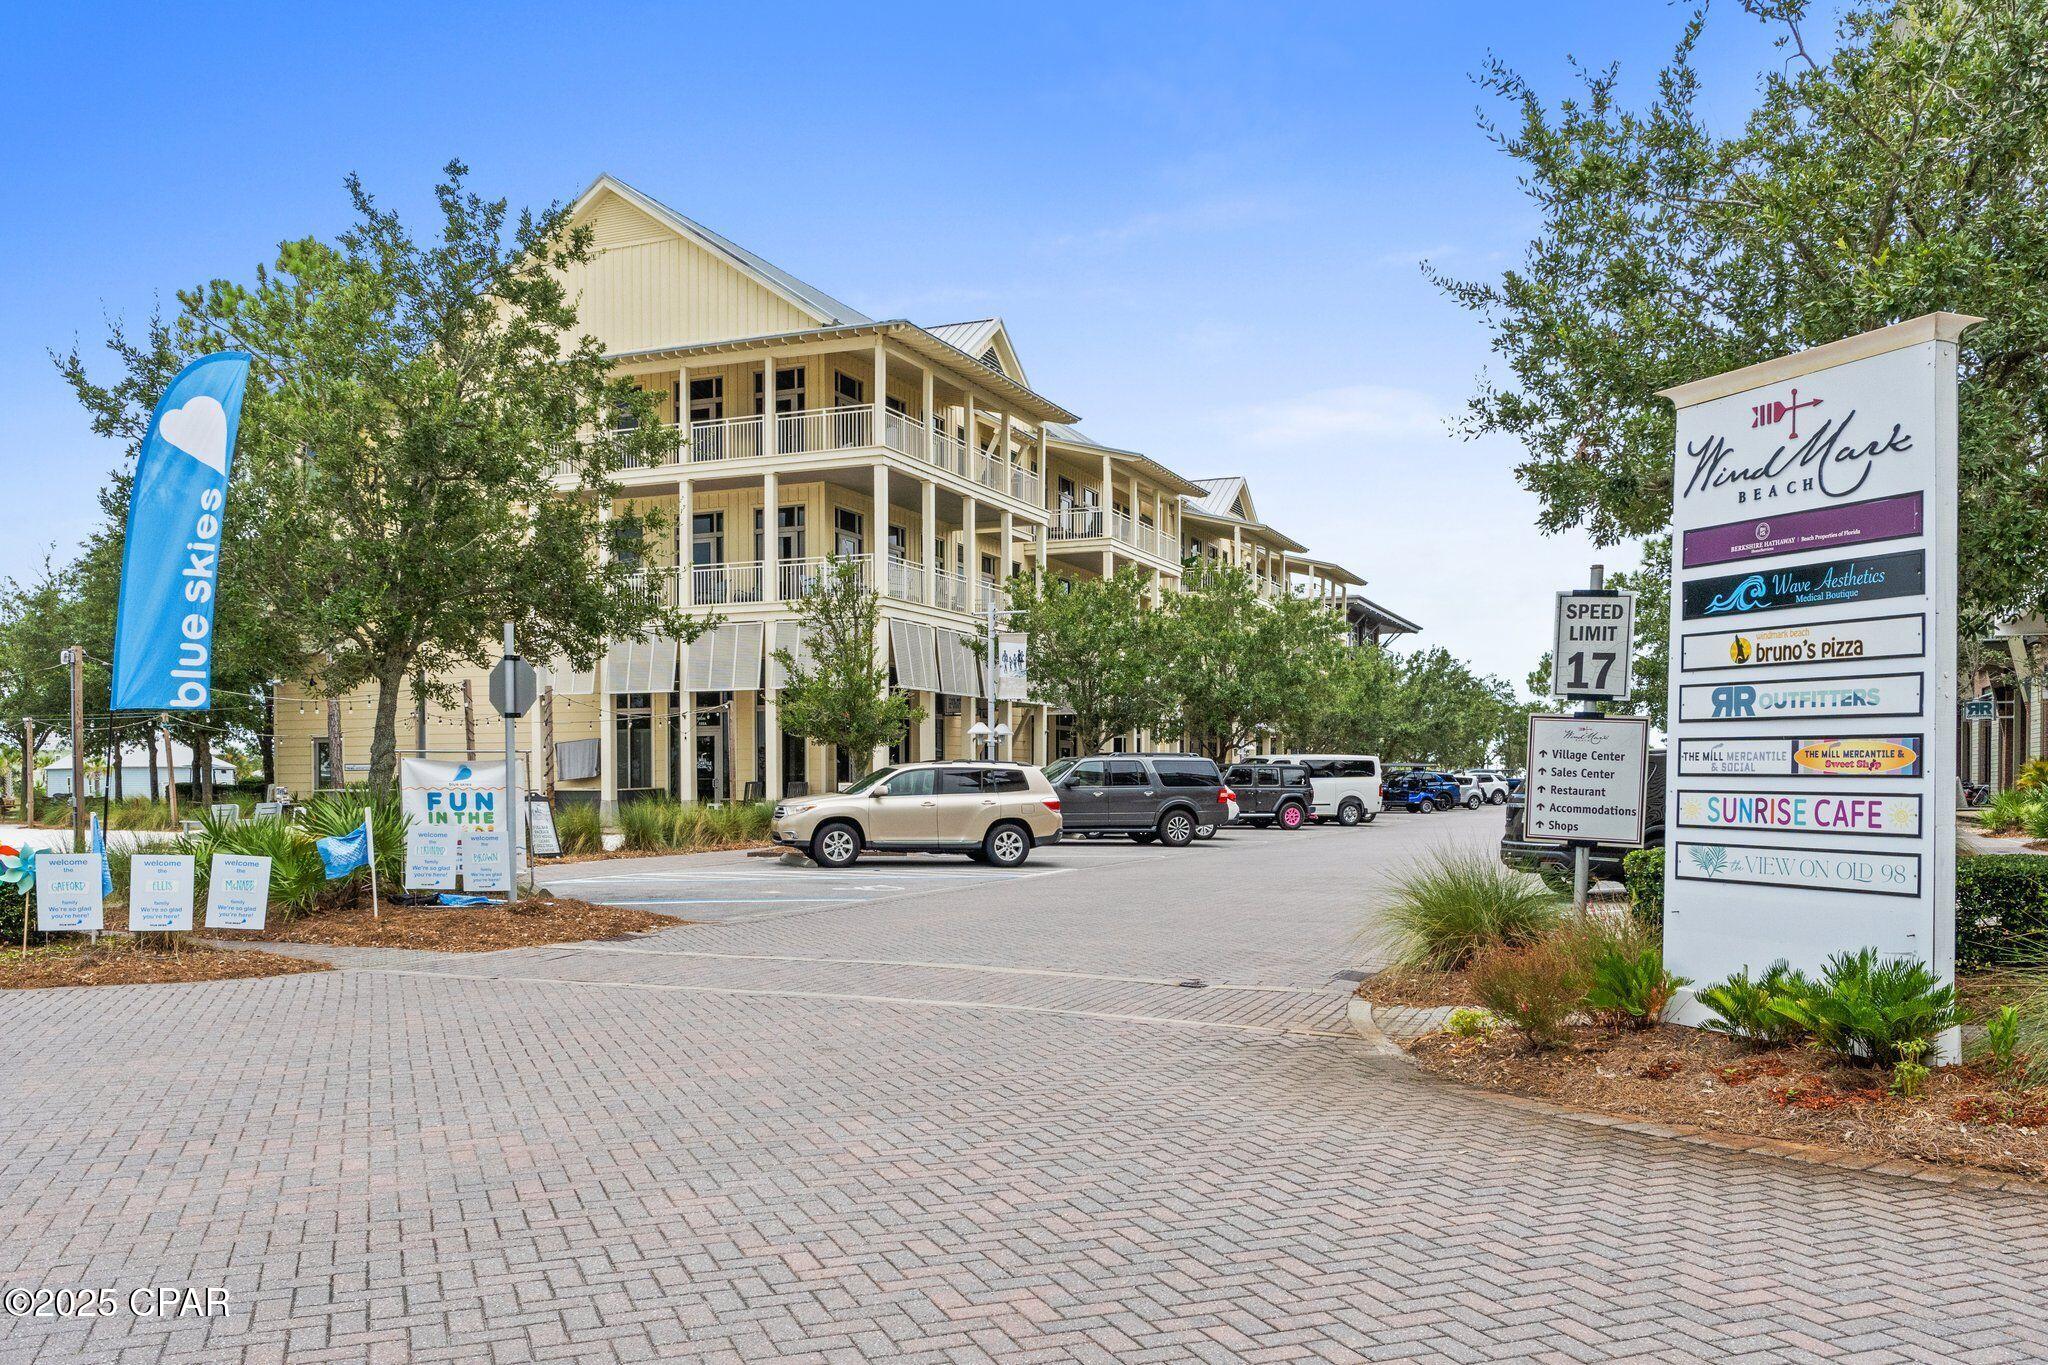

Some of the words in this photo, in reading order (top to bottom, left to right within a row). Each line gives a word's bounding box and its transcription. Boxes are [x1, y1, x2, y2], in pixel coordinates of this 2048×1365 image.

[1739, 478, 1814, 503] BEACH
[182, 488, 222, 604] skies
[1730, 542, 1763, 553] BERKSHIRE
[1764, 537, 1796, 547] HATHAWAY
[1843, 528, 1860, 536] Florida
[1772, 573, 1811, 595] Wave
[1814, 563, 1885, 591] Aesthetics
[1795, 592, 1823, 603] Medical
[1825, 589, 1859, 600] Boutique
[1566, 604, 1623, 620] SPEED
[1569, 625, 1617, 642] LIMIT
[1756, 630, 1788, 640] windmark
[1789, 628, 1810, 637] beach
[1756, 639, 1816, 662] bruno's
[1822, 637, 1863, 658] pizza
[170, 613, 209, 708] blue
[1567, 651, 1616, 689] 17
[1759, 688, 1880, 709] OUTFITTERS
[1552, 749, 1587, 762] Village
[1591, 751, 1625, 761] Center
[1683, 752, 1700, 761] THE
[1702, 751, 1724, 761] MILL
[1726, 751, 1787, 761] MERCANTILE
[1805, 750, 1820, 758] THE
[1821, 750, 1840, 758] MILL
[1842, 750, 1895, 758] MERCANTILE
[1897, 750, 1905, 758] &
[1551, 767, 1577, 778] Sales
[1581, 768, 1615, 779] Center
[1711, 763, 1718, 772] &
[1721, 762, 1755, 772] SOCIAL
[1824, 760, 1855, 768] Sweet
[1856, 759, 1882, 771] Shop
[1550, 785, 1606, 797] Restaurant
[427, 792, 494, 811] FUN
[1549, 803, 1637, 816] Accommodations
[428, 811, 448, 824] IN
[454, 811, 494, 824] THE
[1707, 796, 1806, 826] SUNRISE
[1814, 799, 1882, 828] CAFE
[1548, 820, 1579, 833] Shops
[1728, 860, 1744, 872] the
[1745, 856, 1796, 876] VIEW
[1800, 858, 1828, 878] ON
[1836, 861, 1873, 883] OLD
[1881, 864, 1906, 884] 98
